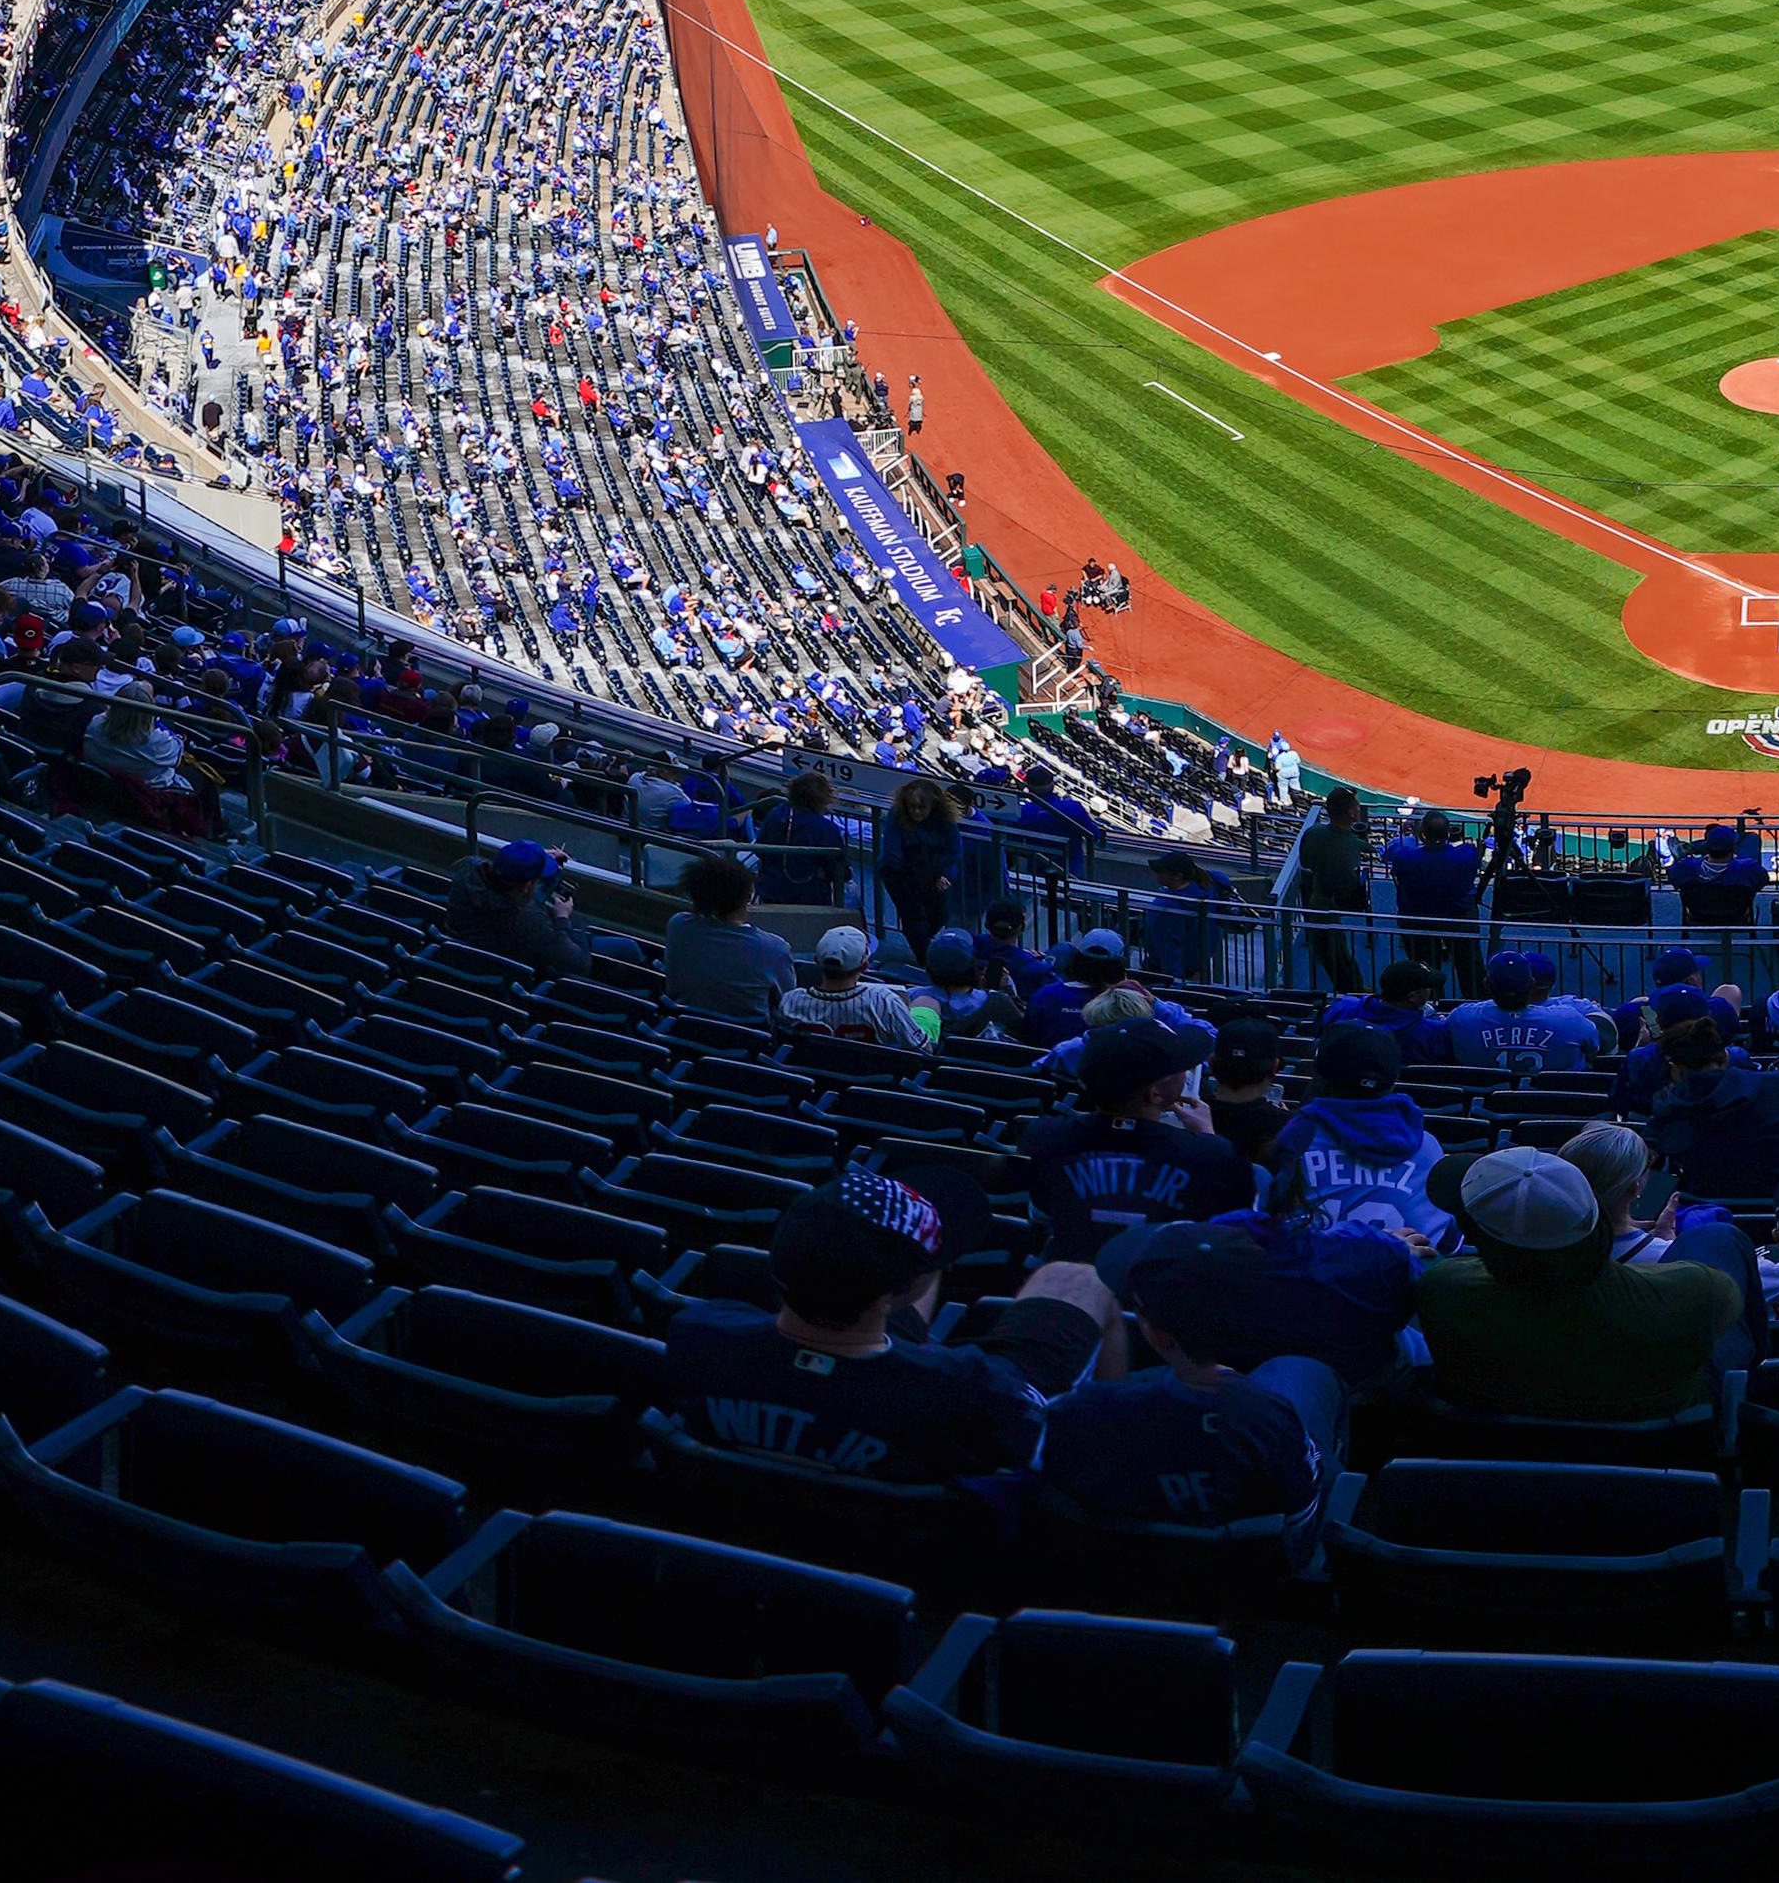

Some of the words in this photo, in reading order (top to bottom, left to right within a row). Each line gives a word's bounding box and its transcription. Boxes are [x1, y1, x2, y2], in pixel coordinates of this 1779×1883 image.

[734, 243, 766, 279] UMB
[747, 280, 765, 305] DUGOUT
[756, 305, 776, 331] SUITES
[844, 485, 900, 549] KAUFFMAN
[886, 539, 943, 603] STADIUM
[935, 605, 961, 636] KC
[1481, 1027, 1556, 1050] PEREZ
[1062, 1153, 1144, 1199] WITT
[1304, 1150, 1419, 1195] PEREZ
[705, 1395, 818, 1456] WITT
